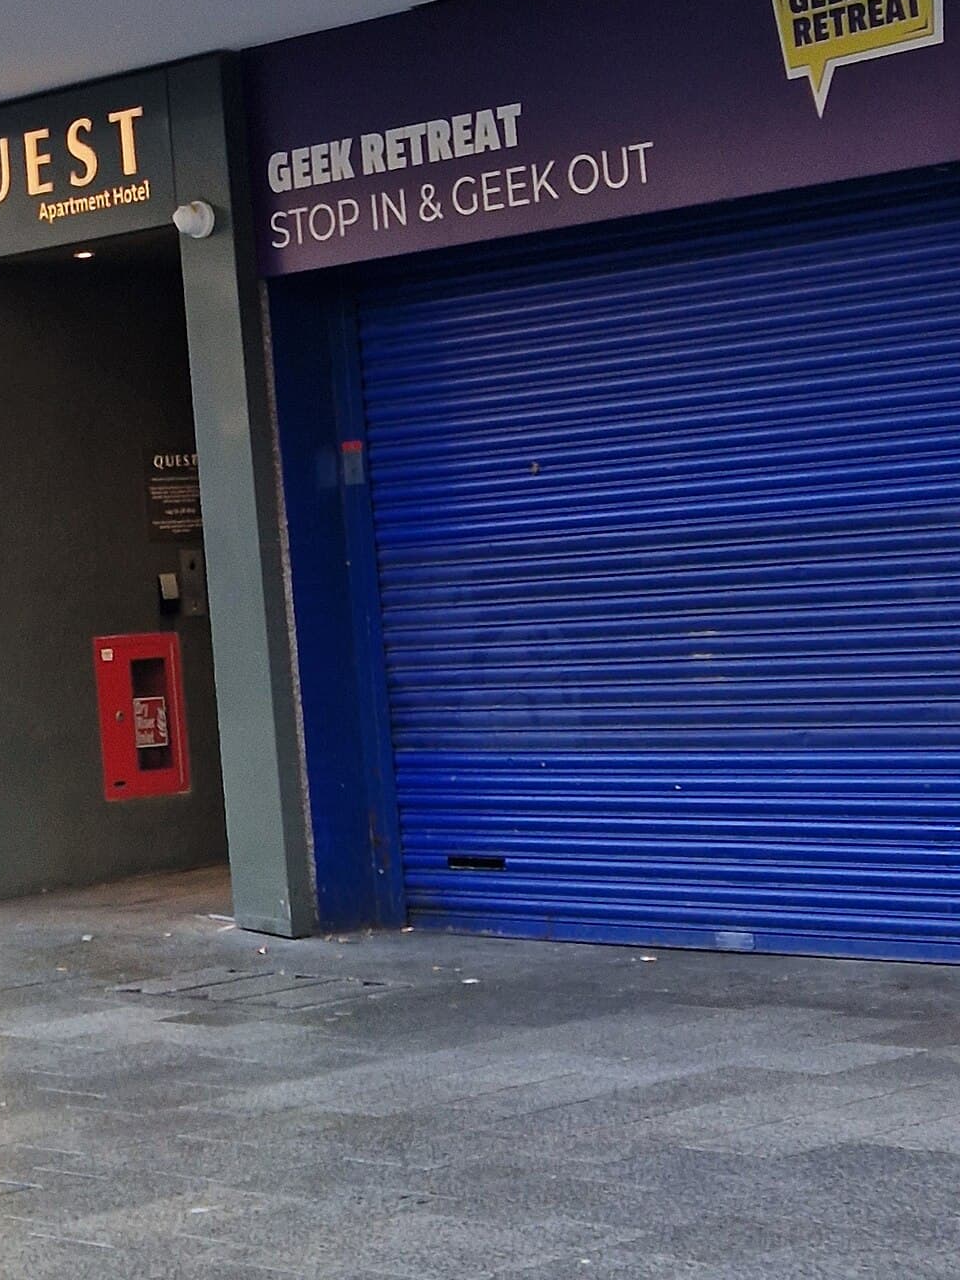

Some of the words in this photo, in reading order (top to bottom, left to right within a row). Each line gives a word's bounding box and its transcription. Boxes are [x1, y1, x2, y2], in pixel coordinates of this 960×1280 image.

[268, 138, 355, 193] GEEK
[361, 103, 522, 175] RETREAT
[39, 191, 110, 225] Apartment
[113, 179, 150, 204] Hotel
[271, 200, 360, 248] STOP
[371, 189, 407, 230] IN
[419, 184, 444, 222] &
[452, 160, 559, 216] GEEK
[567, 142, 654, 195] OUT
[153, 454, 198, 469] QUEST
